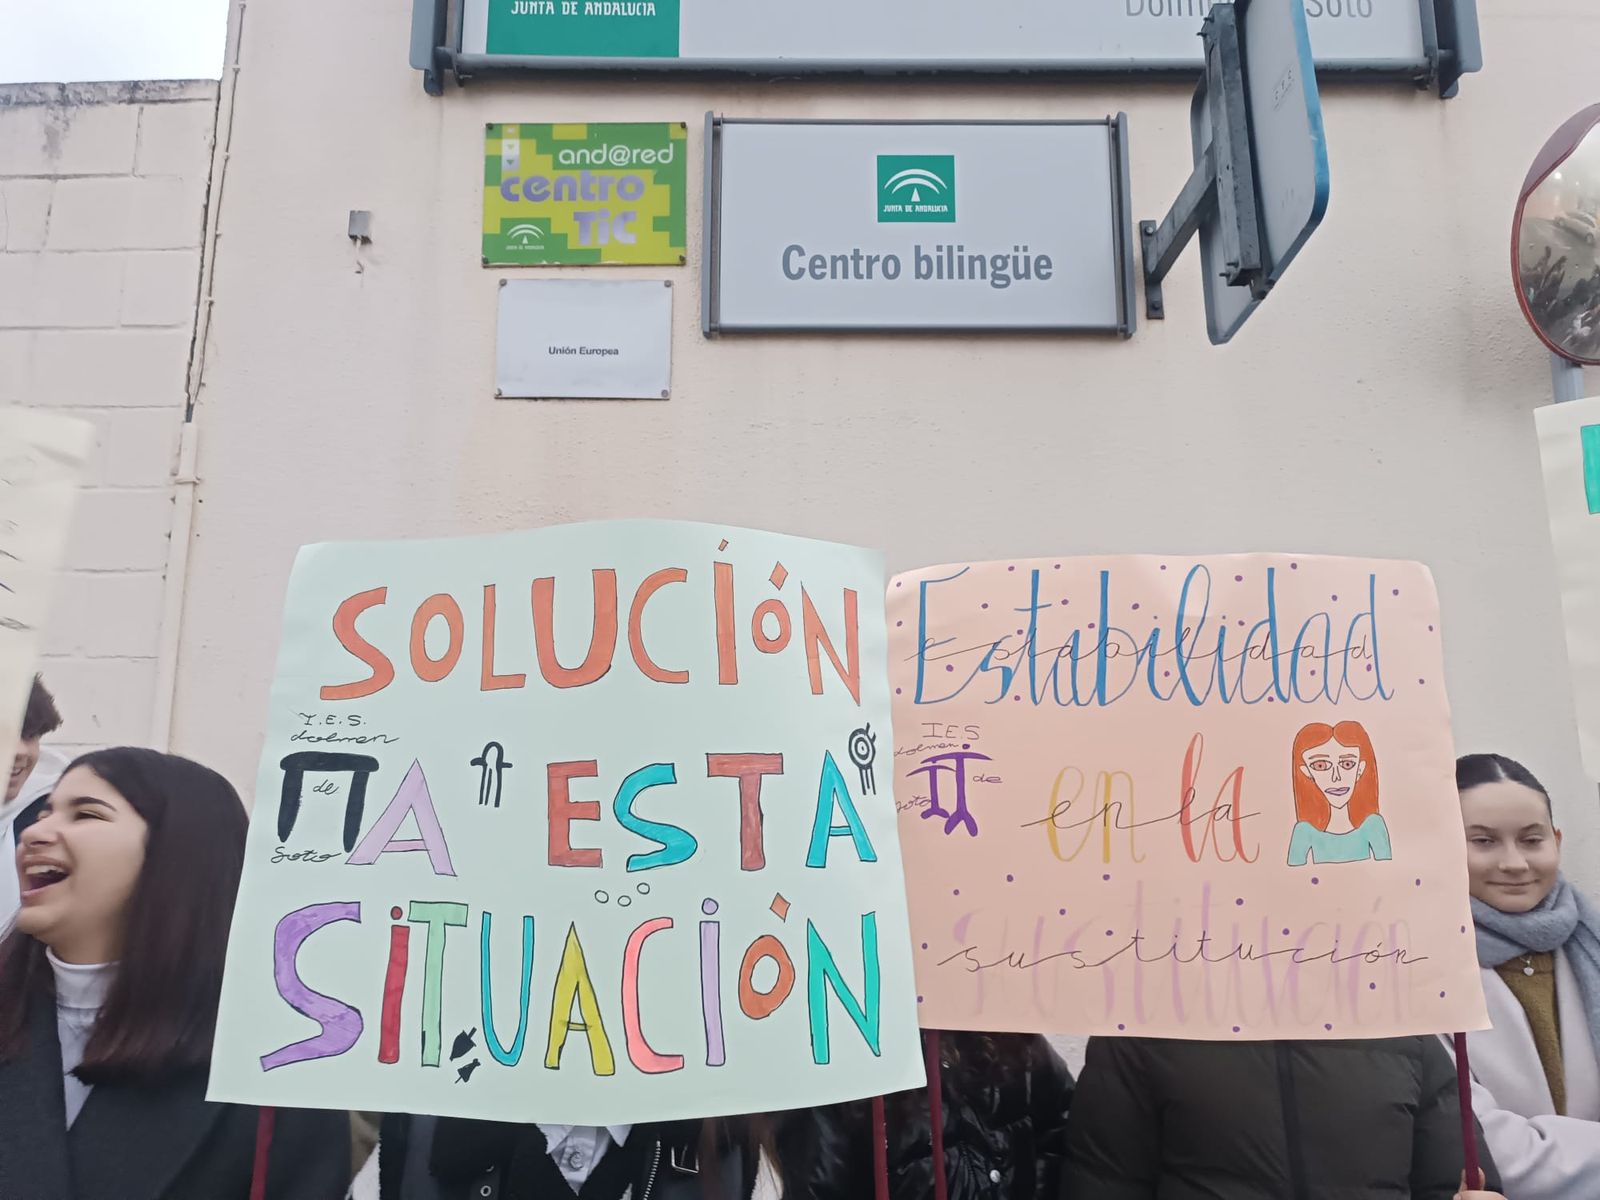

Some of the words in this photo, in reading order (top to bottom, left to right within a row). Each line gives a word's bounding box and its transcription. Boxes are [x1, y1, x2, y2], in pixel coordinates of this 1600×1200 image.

[511, 0, 555, 15] JUNTA
[561, 1, 578, 15] DE
[584, 1, 656, 16] ANDALUCIA
[558, 142, 674, 167] and@red
[501, 169, 645, 202] centro
[883, 204, 903, 213] JUNTA
[904, 204, 913, 213] DE
[782, 244, 901, 281] Centro
[914, 244, 1054, 290] bilingüe
[548, 346, 577, 356] Unión
[579, 346, 619, 357] Europea
[312, 778, 340, 796] de
[972, 773, 1003, 784] de
[1021, 765, 1146, 865] en
[1176, 732, 1261, 864] la
[546, 749, 878, 872] ESTA
